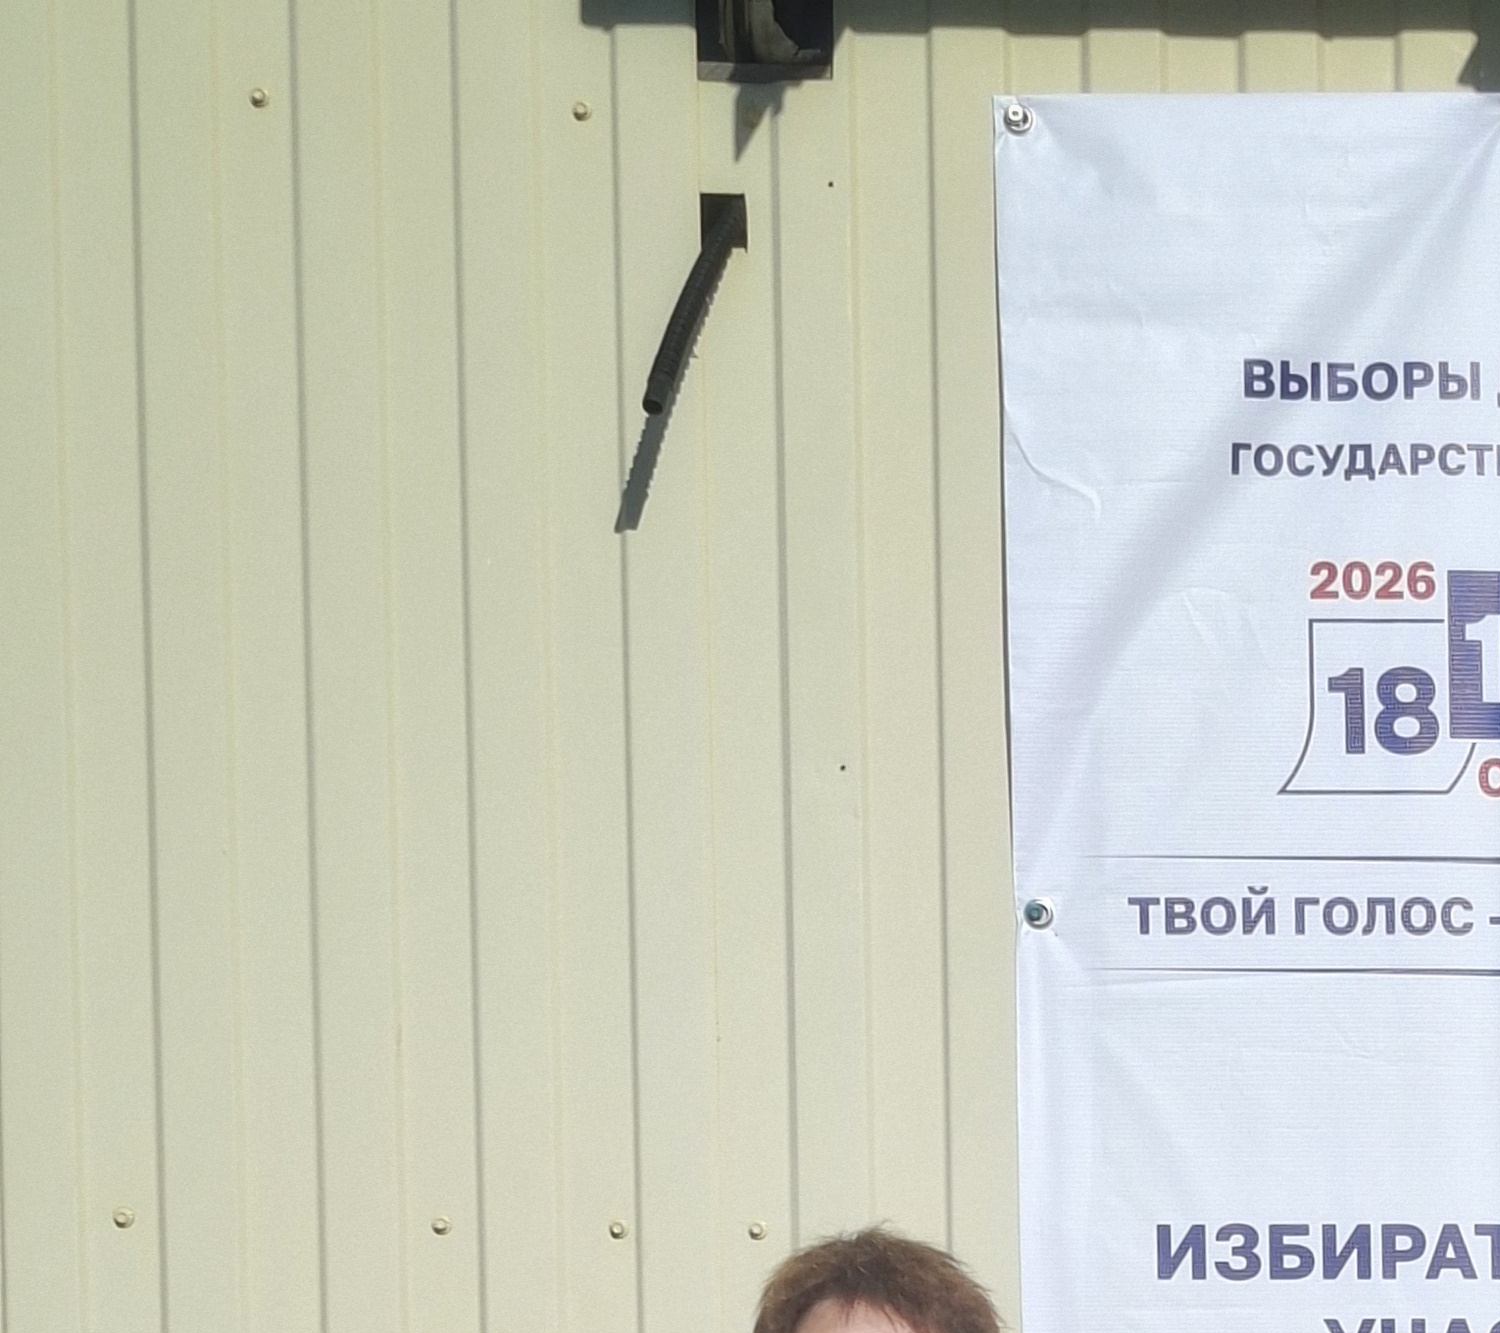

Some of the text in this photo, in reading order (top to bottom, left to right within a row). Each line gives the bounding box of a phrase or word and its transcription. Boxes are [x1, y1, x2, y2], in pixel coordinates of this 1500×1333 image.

[1245, 359, 1481, 404] ВЫБОРЫ
[1311, 562, 1437, 601] 2026
[1329, 667, 1440, 757] 18
[1128, 887, 1277, 937] ТВОЙ
[1295, 897, 1475, 937] ГОЛОС
